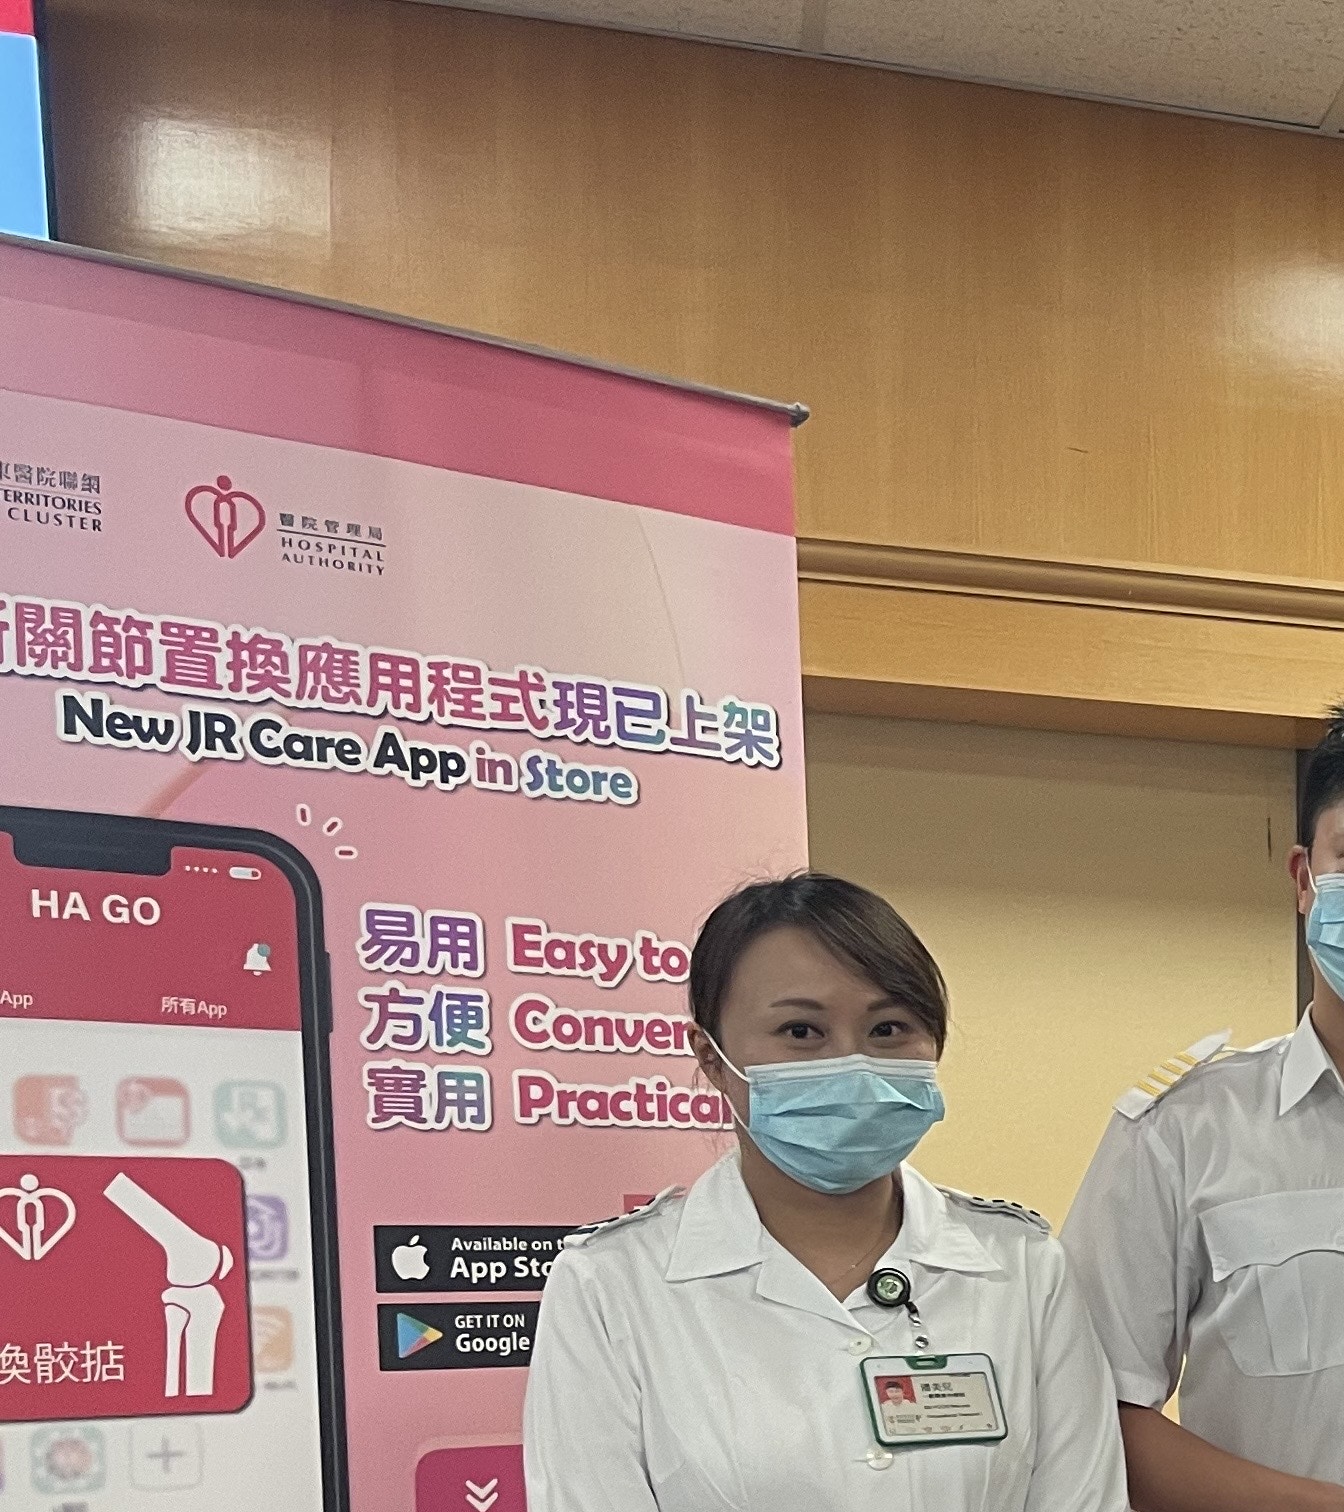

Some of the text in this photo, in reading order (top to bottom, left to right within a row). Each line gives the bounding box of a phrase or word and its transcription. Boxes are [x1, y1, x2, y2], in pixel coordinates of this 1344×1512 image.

[0, 488, 102, 516] ERRITORIES
[7, 506, 102, 532] CLUSTER
[281, 537, 384, 562] HOSPITAL
[281, 552, 385, 576] AUTHORITY
[64, 695, 634, 800] New JR Care App in Store
[31, 889, 162, 928] HA GO
[363, 908, 479, 973] 易用
[511, 924, 689, 983] Easy to
[161, 995, 229, 1021] 所有App
[362, 987, 491, 1052] 方便
[367, 1069, 487, 1127] 實用
[451, 1237, 553, 1251] Available on
[450, 1256, 507, 1284] App
[454, 1314, 525, 1329] GET IT ON
[456, 1331, 530, 1356] Google
